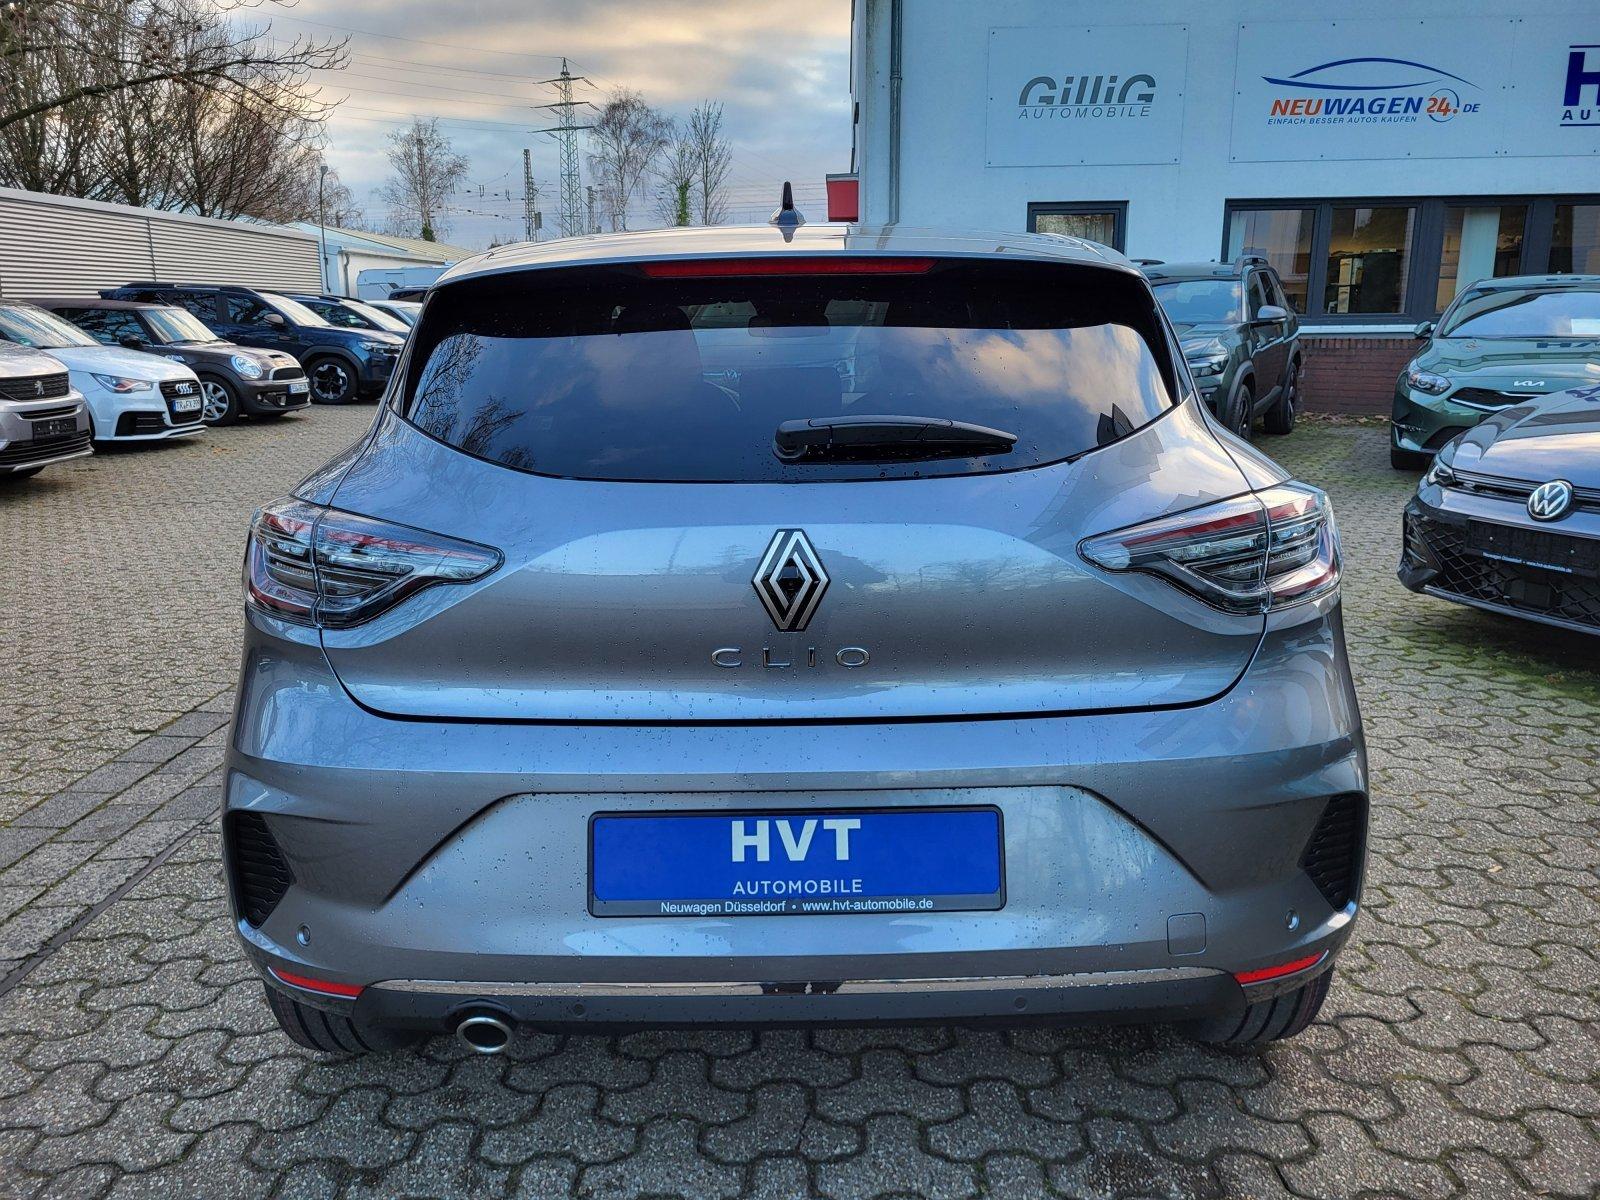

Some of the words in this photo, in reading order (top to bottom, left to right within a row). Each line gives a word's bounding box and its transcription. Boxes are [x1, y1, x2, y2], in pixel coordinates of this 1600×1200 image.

[1018, 106, 1151, 120] AUTOMOBILE
[1267, 117, 1306, 125] EINFACH
[1309, 116, 1345, 124] BESSER
[1347, 116, 1378, 124] AUTOS
[1380, 115, 1418, 123] KAUFEN
[710, 647, 871, 668] CLIO
[731, 818, 861, 863] HVT
[732, 879, 863, 895] AUTOMOBILE
[660, 901, 721, 916] Neuwagen
[724, 900, 787, 913] Düsseldorf
[802, 898, 934, 912] www.hvt-automobile.de
